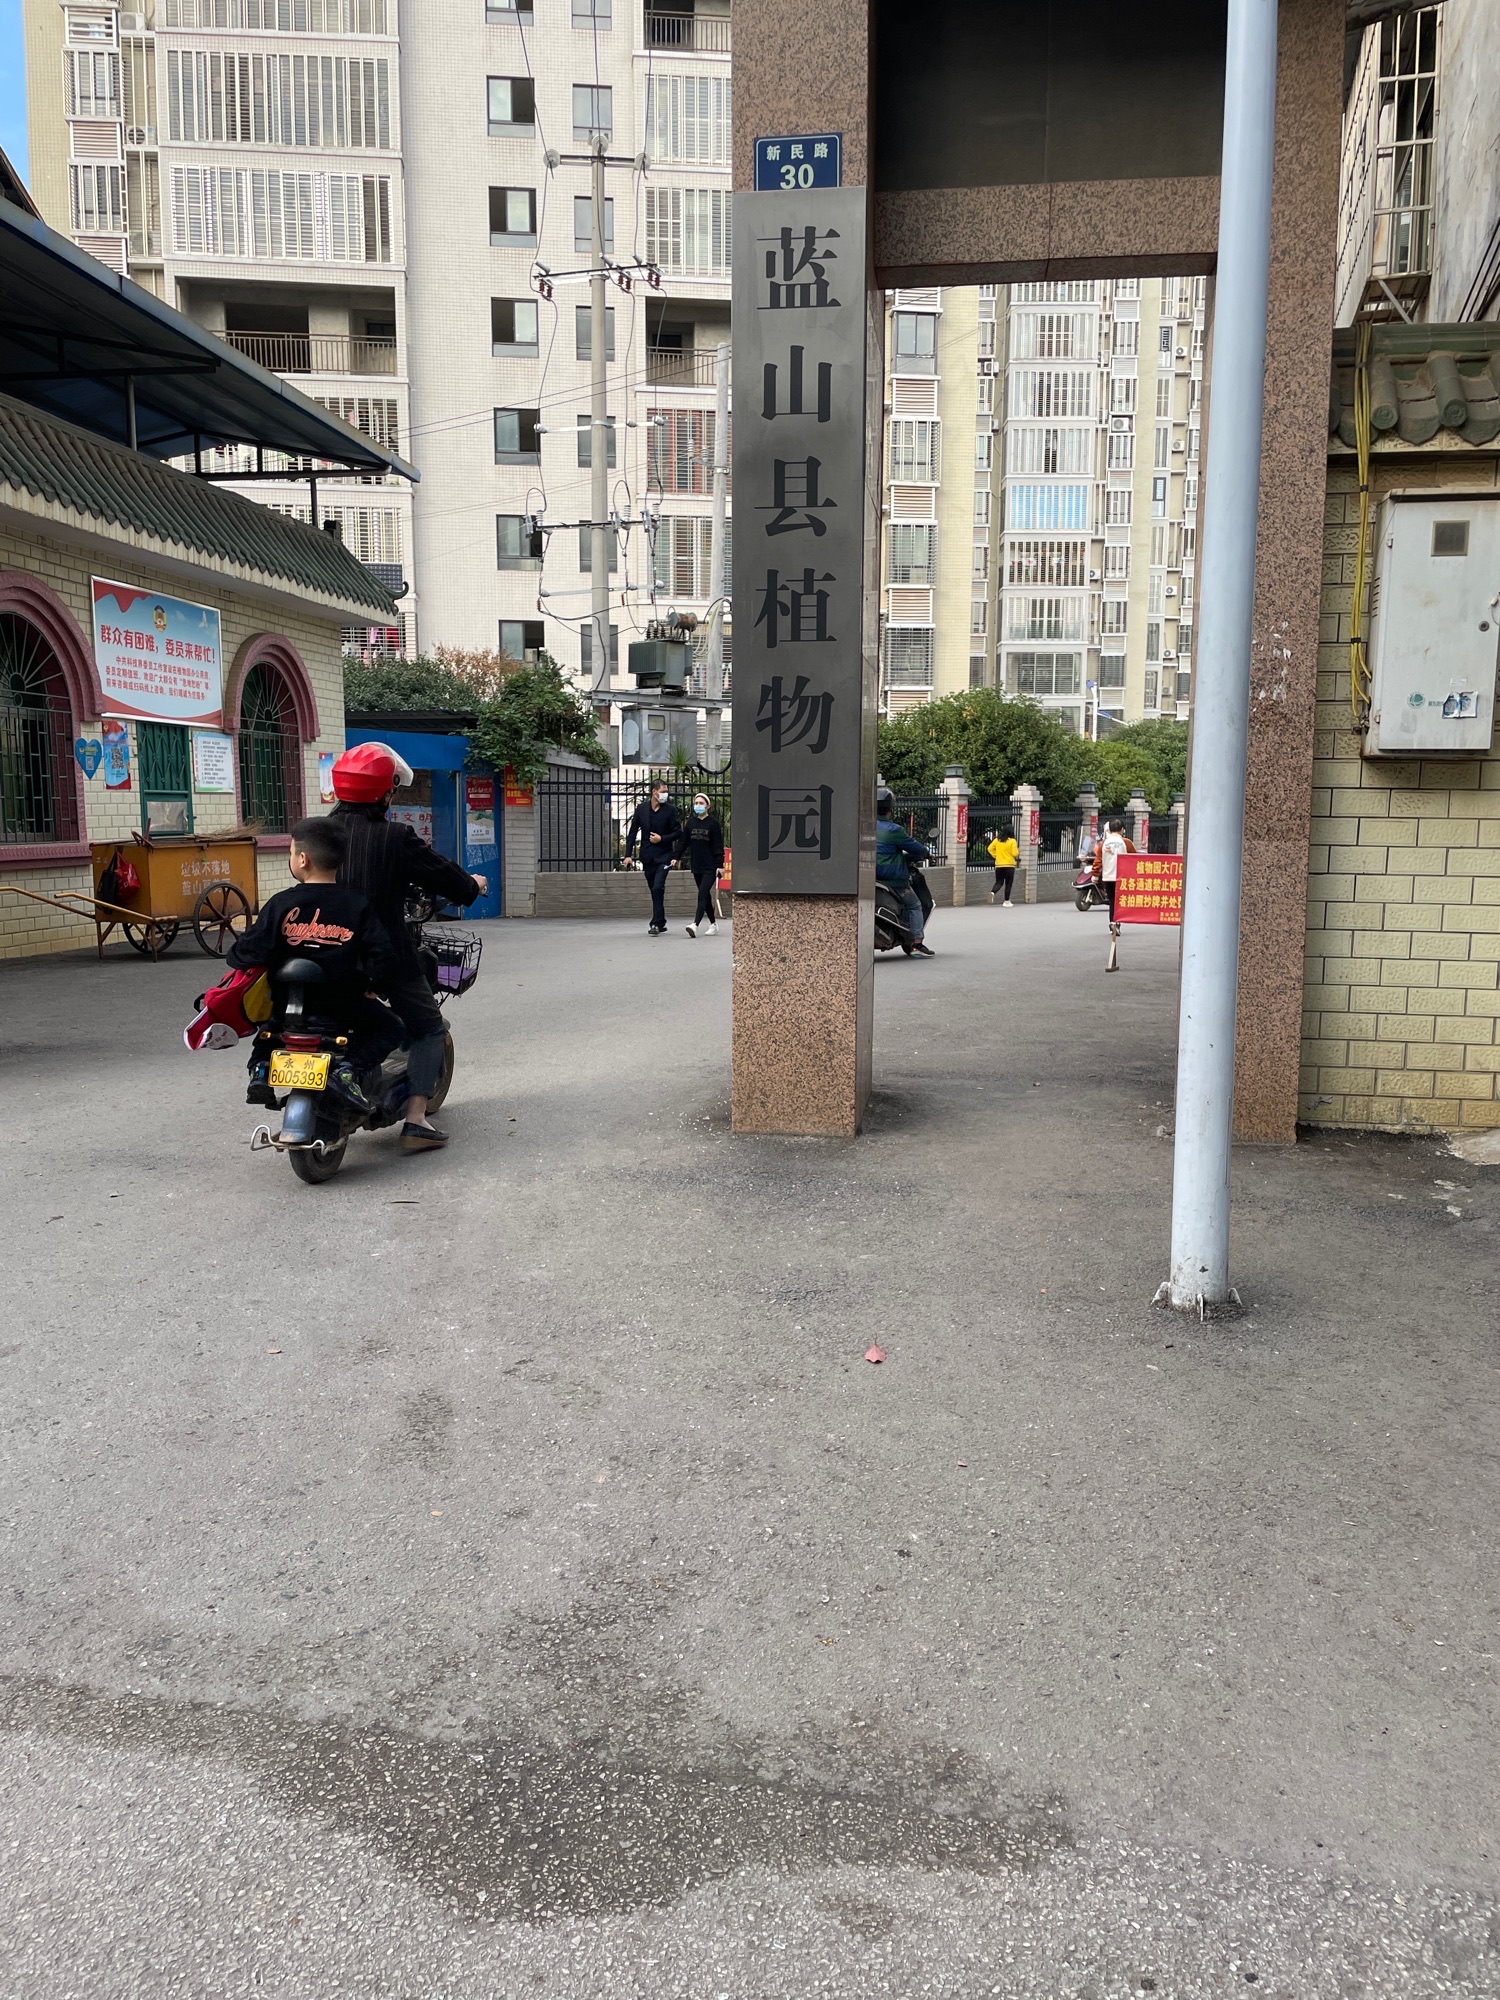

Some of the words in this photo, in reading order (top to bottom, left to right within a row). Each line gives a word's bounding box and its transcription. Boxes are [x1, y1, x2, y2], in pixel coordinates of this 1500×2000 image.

[766, 142, 829, 161] 新民路
[780, 163, 814, 190] 30
[753, 226, 842, 861] 蓝山县植物园
[100, 624, 215, 664] 群众有困难，委员来帮忙！
[181, 860, 230, 877] 垃圾不落地
[284, 1058, 315, 1070] 永州
[271, 1069, 324, 1087] 6005393
